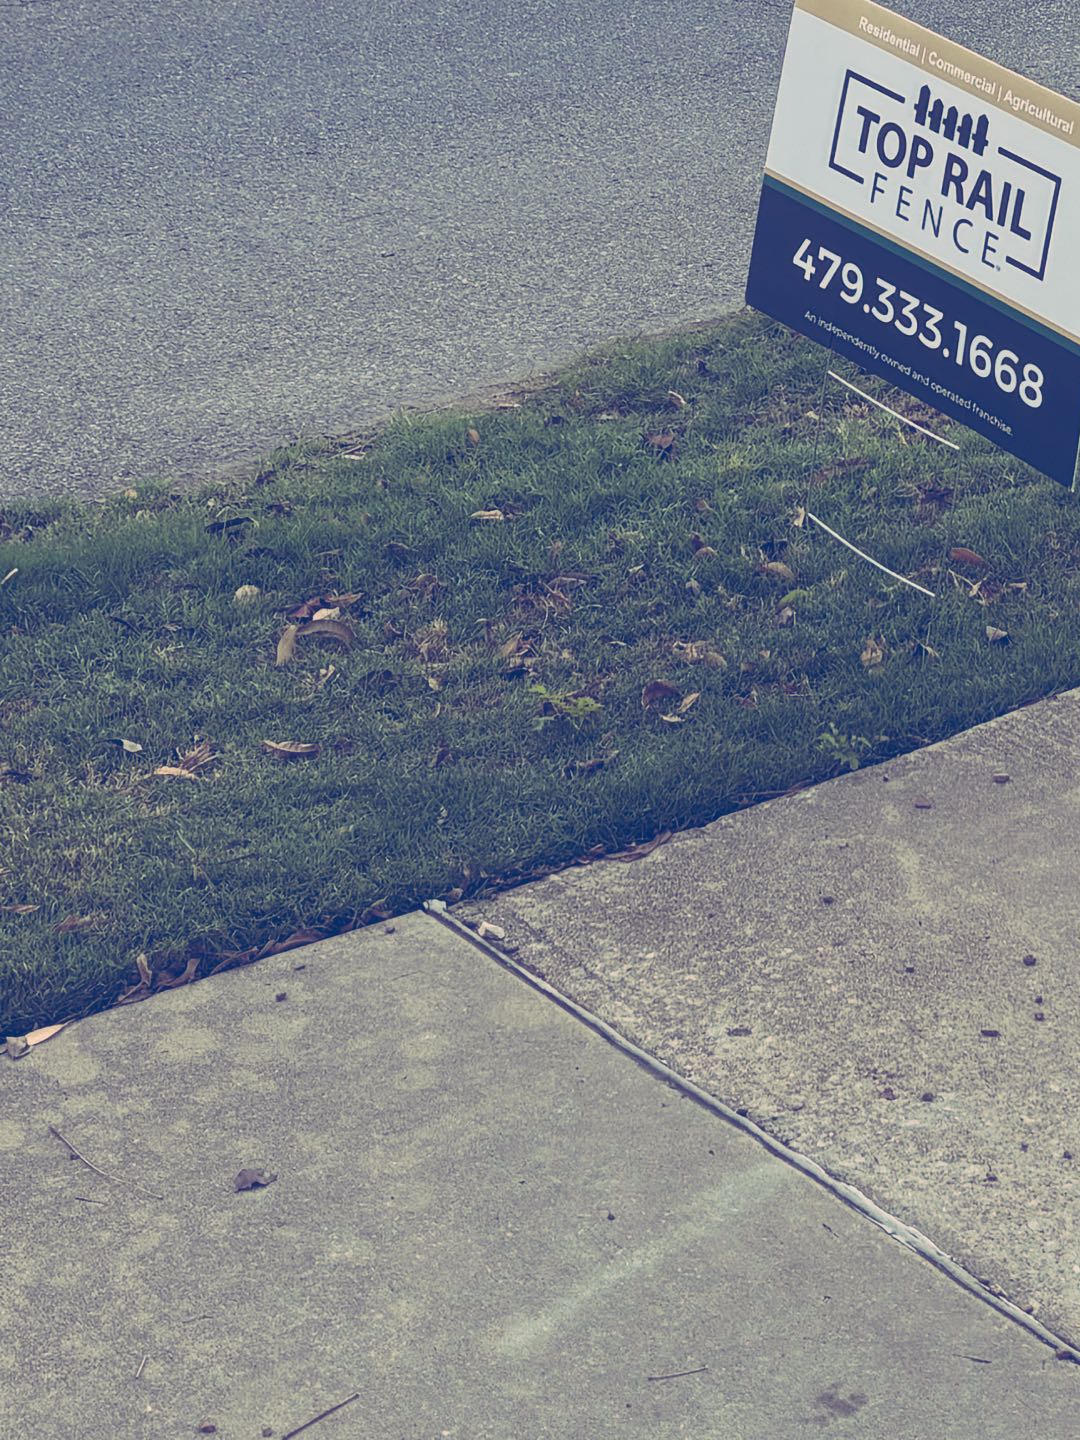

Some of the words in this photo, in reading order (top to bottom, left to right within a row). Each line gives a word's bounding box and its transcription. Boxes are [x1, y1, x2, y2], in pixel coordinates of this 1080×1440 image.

[858, 16, 921, 58] Residential
[928, 51, 996, 96] Commercial
[1003, 88, 1075, 136] Agricultural
[857, 105, 934, 179] TOP
[941, 152, 1031, 241] RAIL
[870, 172, 999, 269] FENCE
[792, 238, 1045, 409] 479.333.1668
[804, 310, 817, 324] An
[817, 316, 880, 360] independently
[880, 352, 911, 376] owned
[911, 370, 931, 387] and
[930, 381, 972, 410] operated
